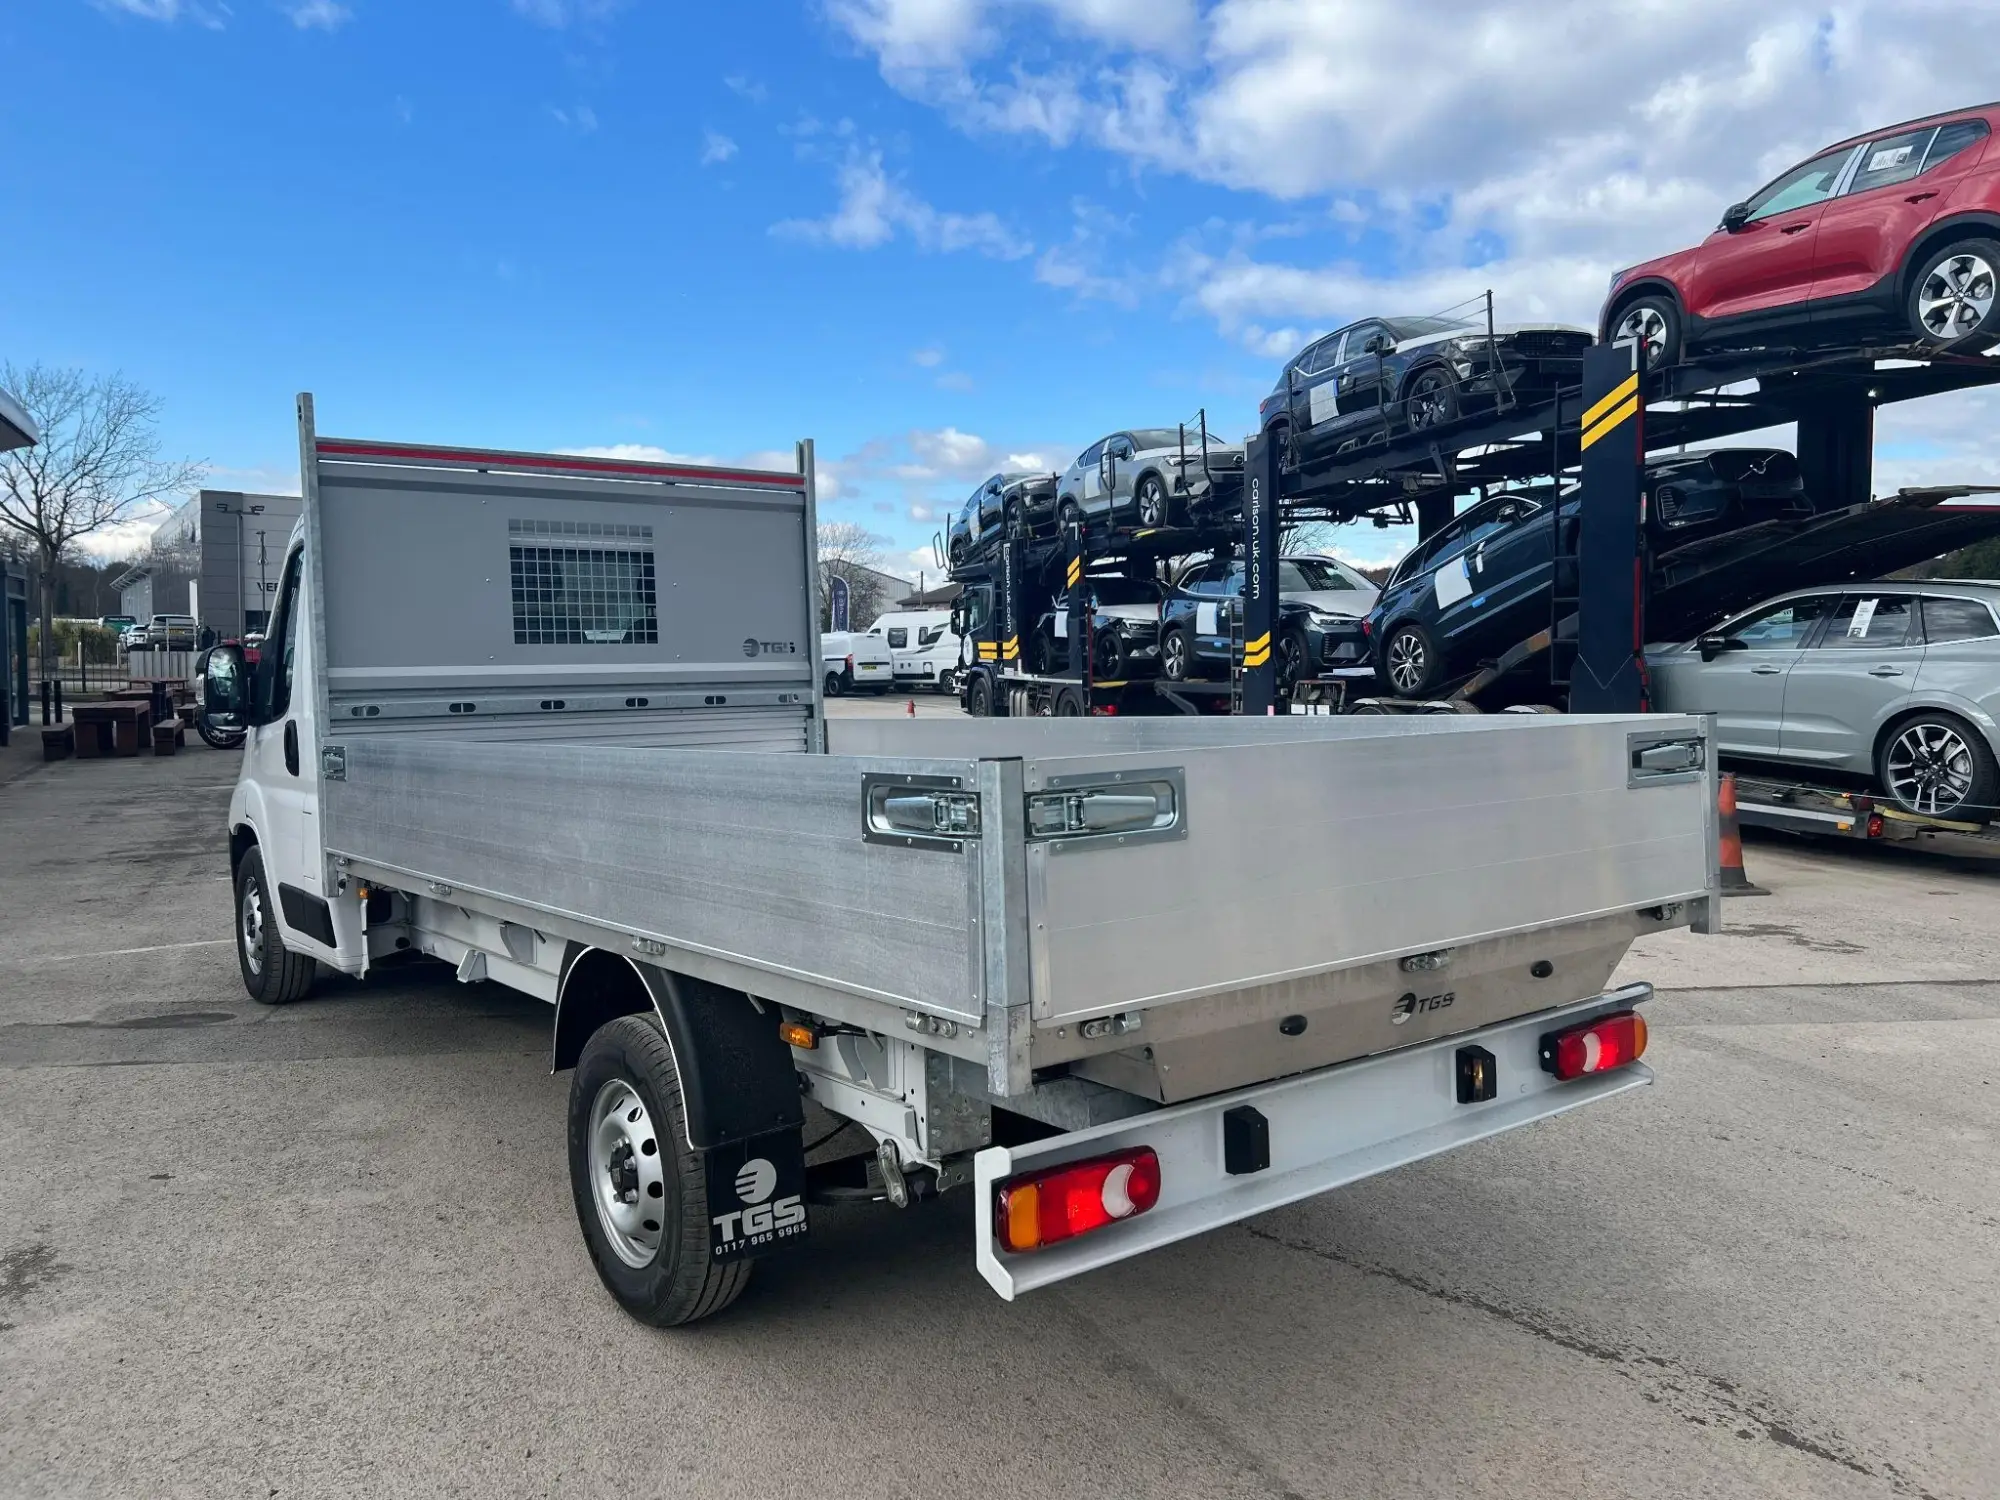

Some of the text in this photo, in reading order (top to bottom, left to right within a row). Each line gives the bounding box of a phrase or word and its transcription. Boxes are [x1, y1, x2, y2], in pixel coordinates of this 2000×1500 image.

[1252, 478, 1260, 599] carlson.uk.com
[760, 642, 796, 654] TGS
[1419, 992, 1456, 1015] TGS
[713, 1194, 806, 1242] TGS
[715, 1239, 746, 1255] 0117
[751, 1231, 773, 1246] 965
